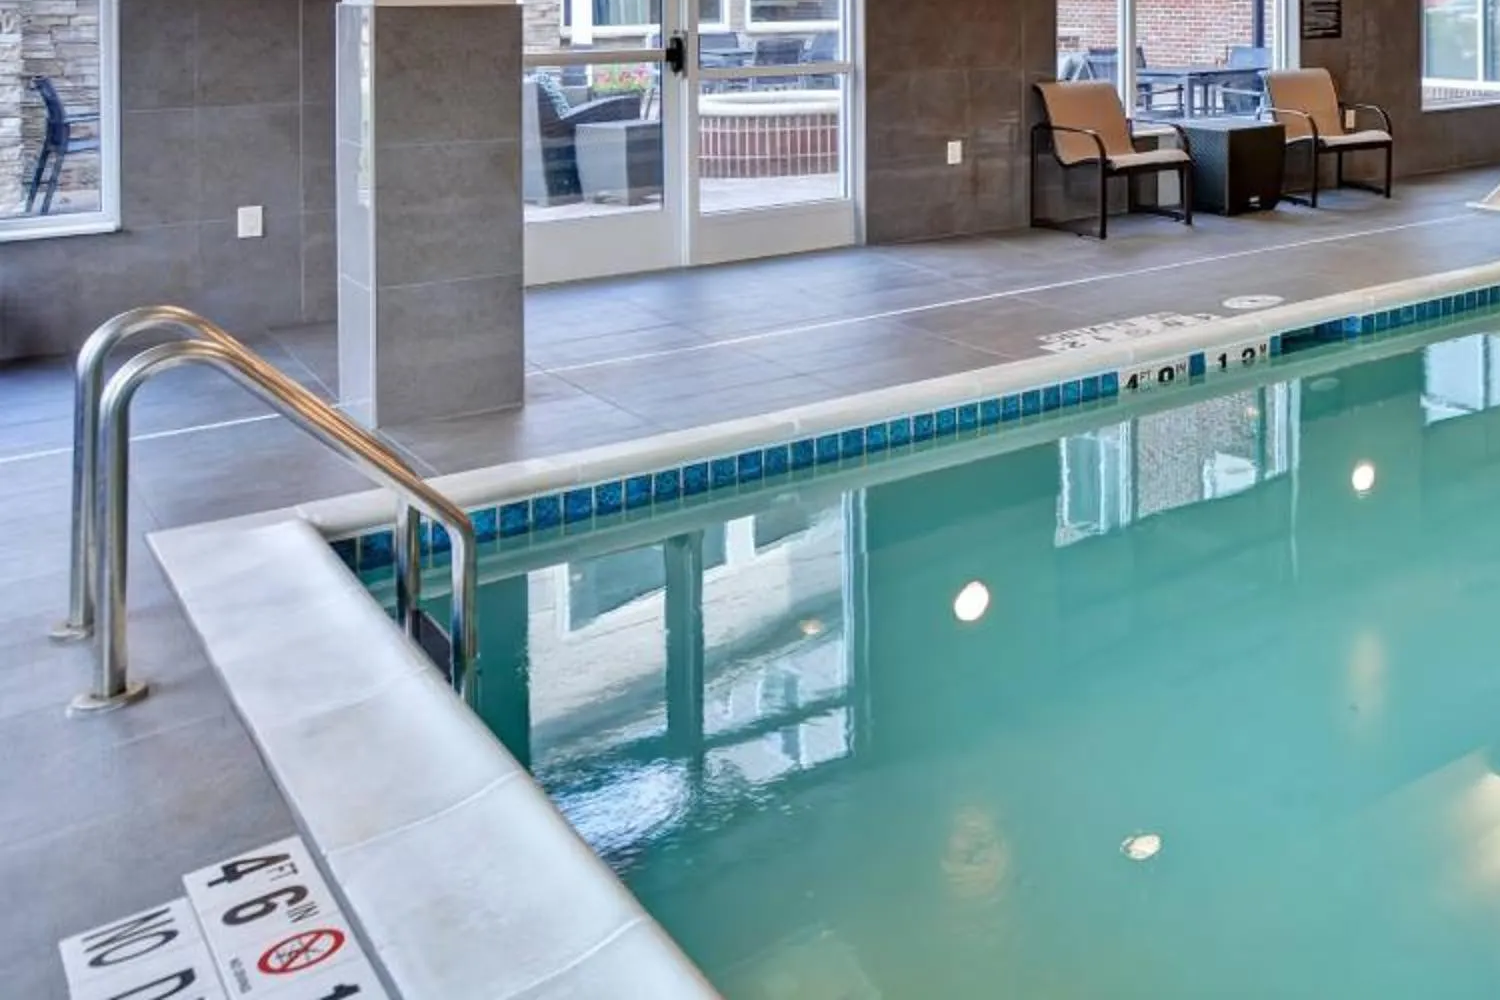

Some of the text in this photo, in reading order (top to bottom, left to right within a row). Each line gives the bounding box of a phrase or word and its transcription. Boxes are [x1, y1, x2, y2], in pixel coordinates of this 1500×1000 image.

[207, 852, 291, 888] 4
[221, 884, 309, 926] 6
[81, 907, 180, 968] NO
